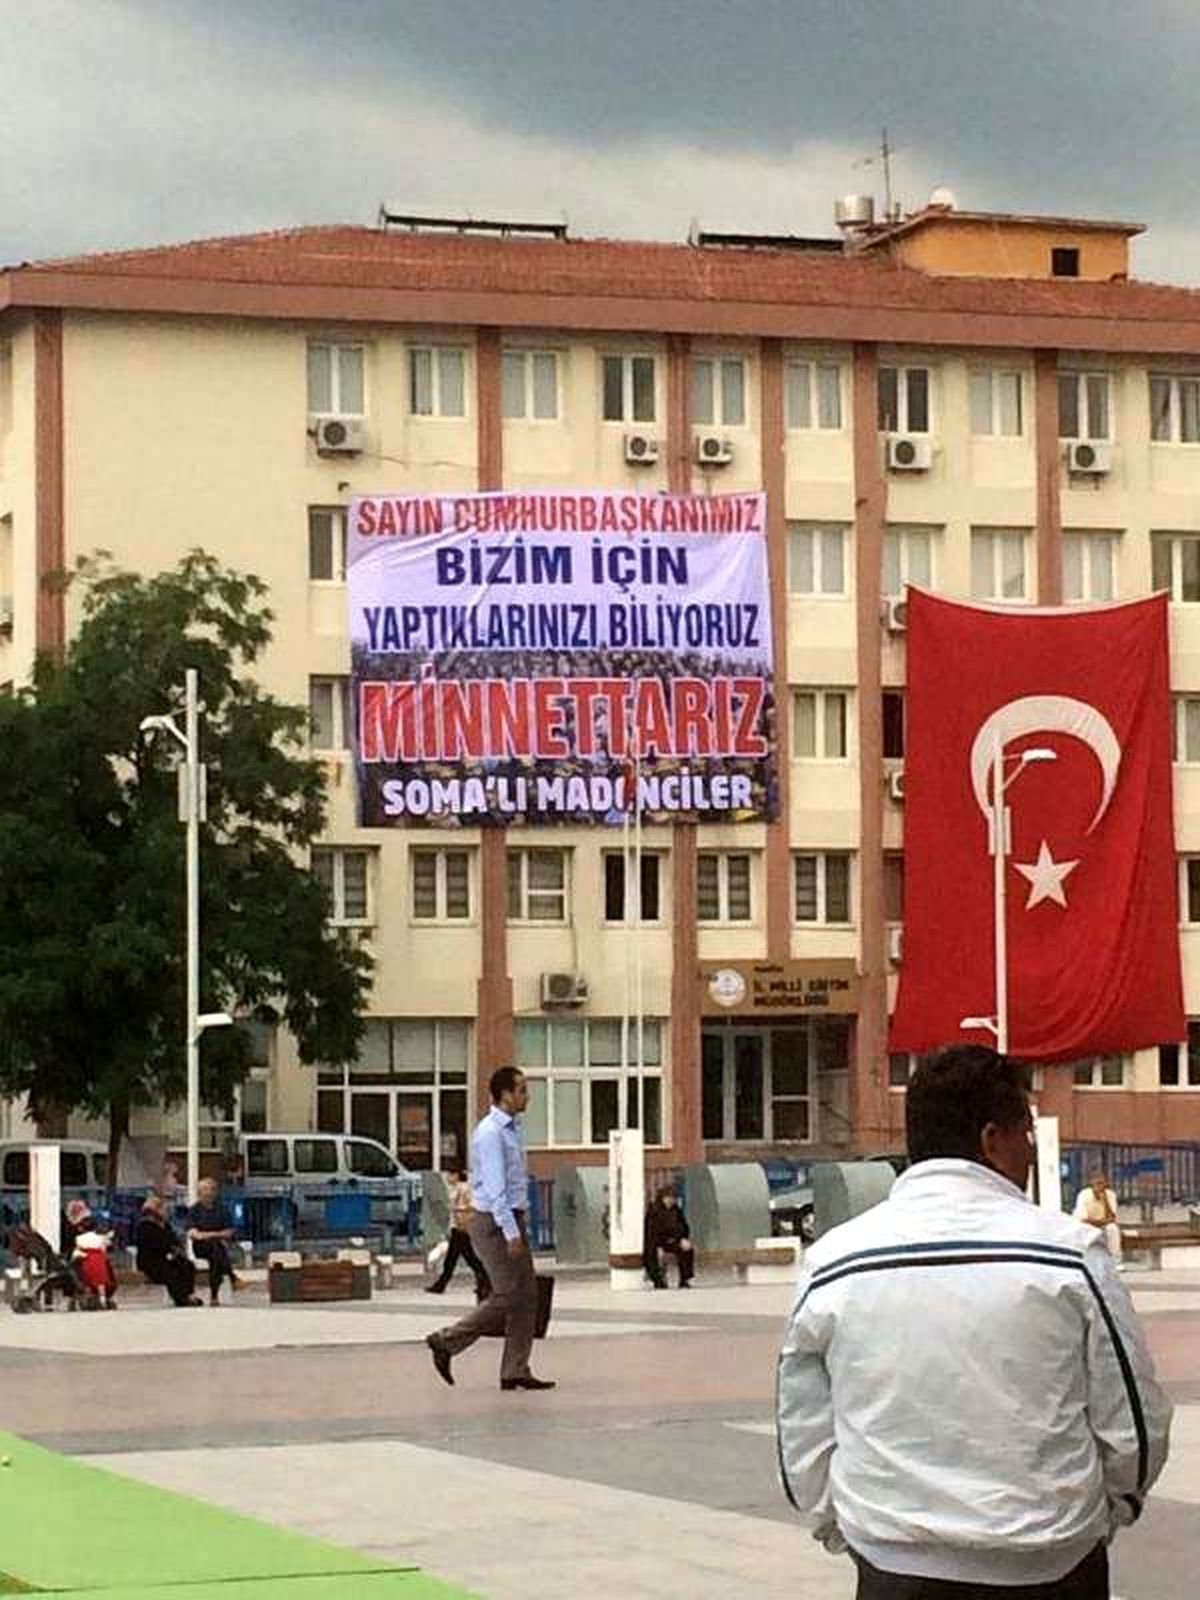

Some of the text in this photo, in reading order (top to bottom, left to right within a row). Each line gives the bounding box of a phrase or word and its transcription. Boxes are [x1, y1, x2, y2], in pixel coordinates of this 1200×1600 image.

[357, 493, 761, 538] SAYIN CUMHURBAŞKANIMIZ
[436, 539, 688, 592] BİZİM İÇİN
[363, 596, 760, 651] YAPTIKLARINIZI BİLİYORUZ
[359, 663, 768, 763] MİNNETTARIZ
[382, 777, 526, 816] SOMA'LI
